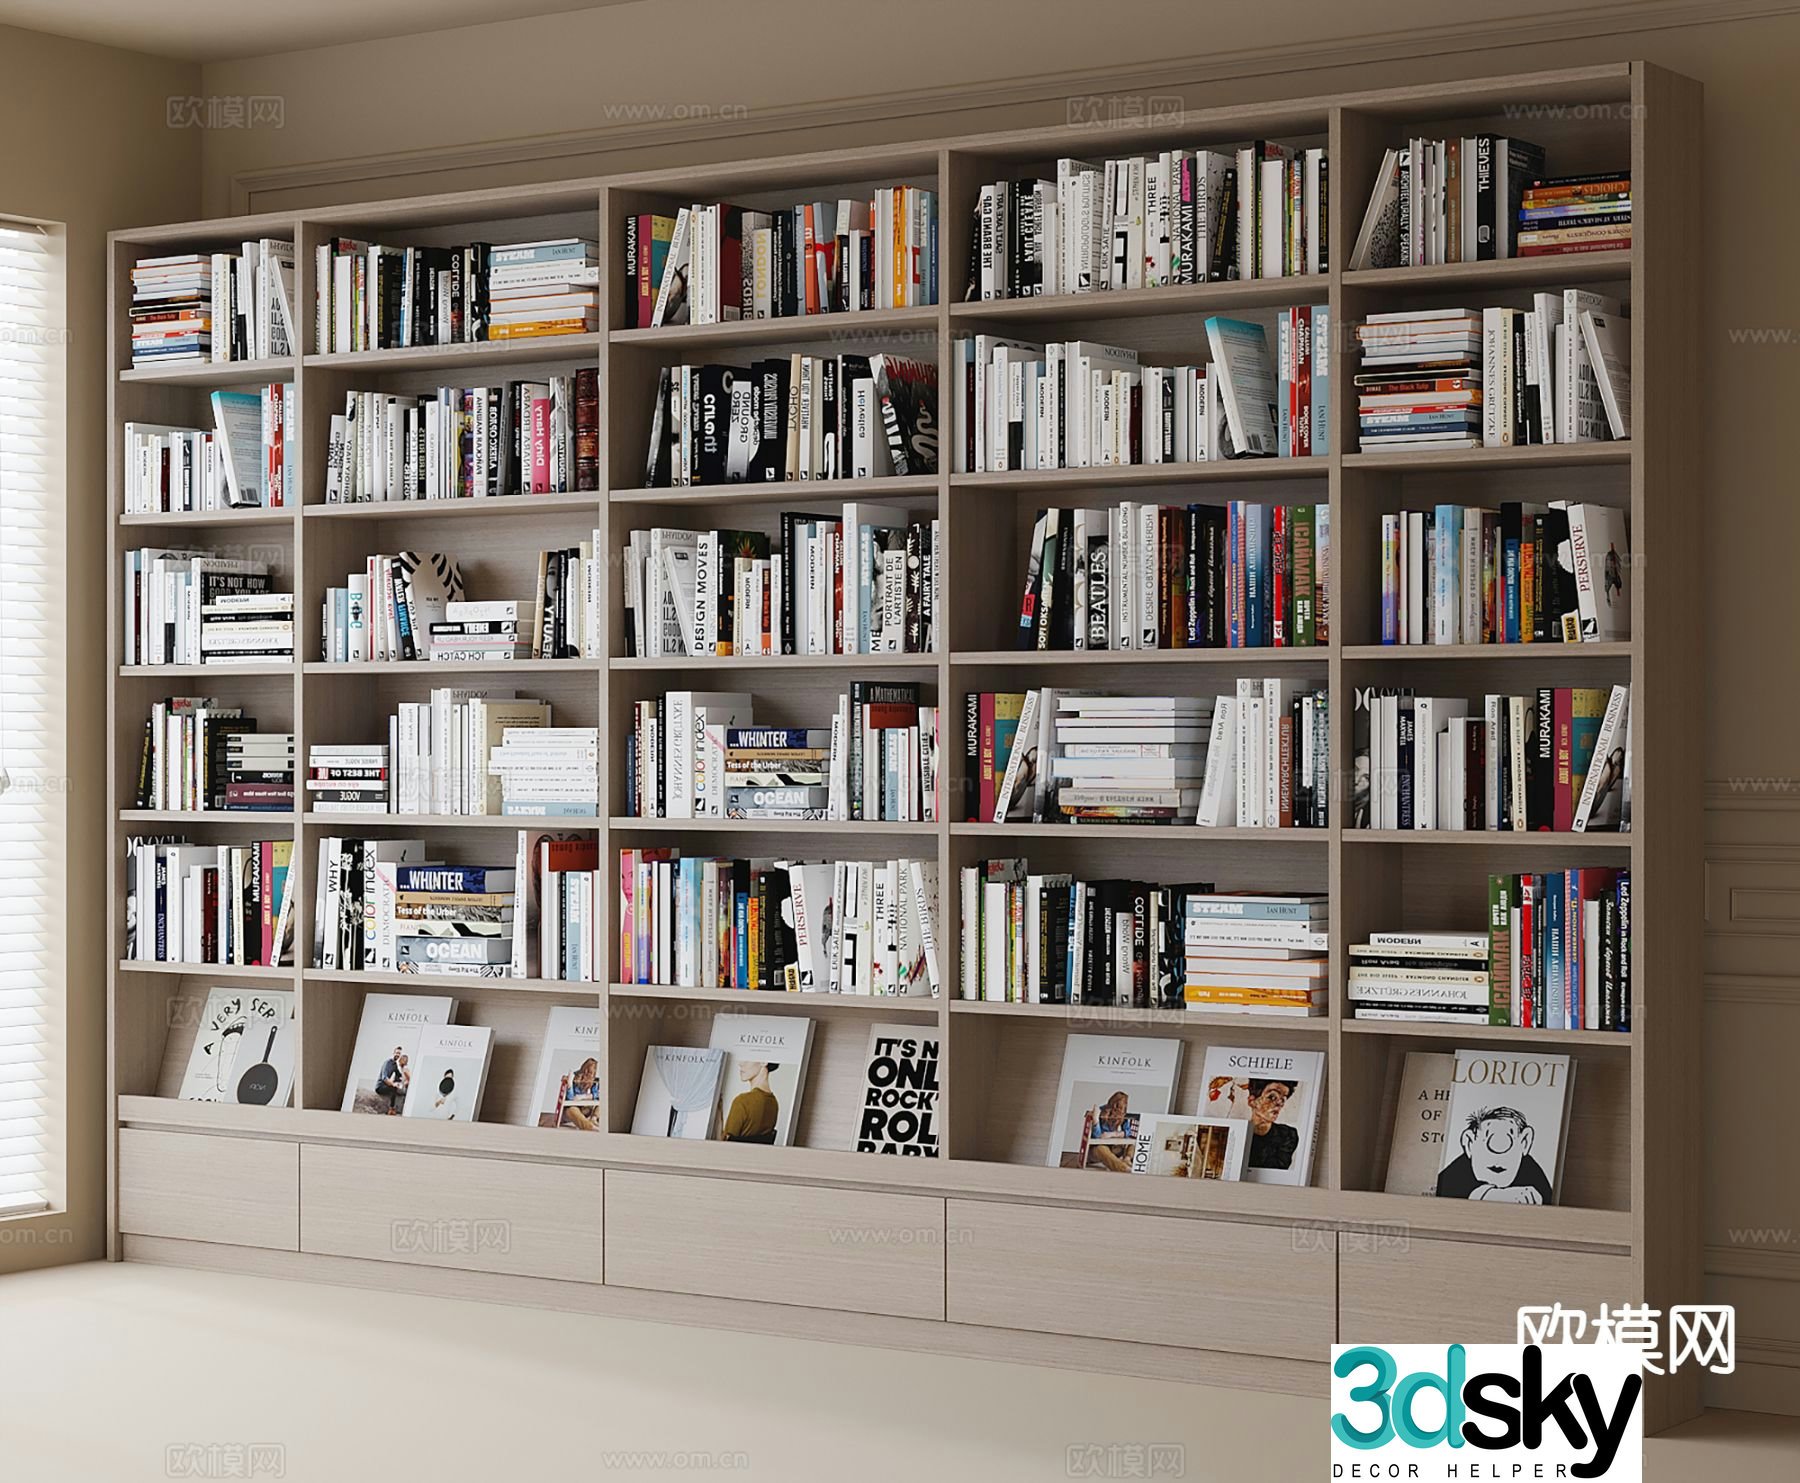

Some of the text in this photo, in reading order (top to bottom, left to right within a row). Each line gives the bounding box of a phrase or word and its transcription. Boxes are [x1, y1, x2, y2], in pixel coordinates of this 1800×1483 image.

[1478, 137, 1490, 193] THIEVES
[1147, 176, 1157, 216] THREE
[1173, 160, 1182, 241] NATIONAL PARK
[1198, 176, 1206, 241] THE BIRDS
[627, 216, 637, 276] MURAKAMI
[1181, 205, 1193, 285] MURAKAMI
[657, 252, 677, 311] INTERNATIONAL
[1487, 329, 1497, 388] JOHANNES
[209, 576, 265, 588] IT'S NOT HOW
[923, 555, 931, 581] TALE
[1121, 507, 1129, 622] INSTRUMENTAL NUMBER BUILDING
[1146, 514, 1154, 621] DESIRE OBTAIN CHERISH
[1573, 523, 1591, 592] PERSERVE
[694, 542, 709, 651] DESIGN MOVES
[885, 573, 893, 627] PORTRAIT
[894, 573, 903, 625] L'ARTISTE
[923, 583, 931, 608] FAIRY
[1089, 551, 1106, 641] BEATLES
[967, 694, 977, 756] MURAKAMI
[1002, 696, 1035, 800] INTERNATIONAL BUSINESS
[1539, 690, 1551, 758] MURAKAMI
[1581, 691, 1623, 806] INTERNATIONAL BUSINESS
[695, 713, 705, 792] color index
[727, 760, 743, 770] Tess
[753, 791, 806, 806] OCEAN
[1400, 774, 1411, 827] ENCHANTRESS
[252, 842, 261, 903] MURAKAMI
[328, 860, 339, 893] WHY
[365, 849, 376, 941] color index
[397, 906, 415, 916] Tess
[791, 884, 808, 947] PERSERVE
[900, 867, 909, 951] NATIONAL PARK
[1279, 906, 1297, 915] HUNT
[1621, 896, 1630, 929] Zeppelin
[425, 942, 482, 960] OCEAN
[203, 1042, 214, 1055] A
[210, 998, 240, 1032] VERY
[387, 1012, 431, 1023] KINFOLK
[438, 1039, 473, 1048] KINFOLK
[739, 1034, 785, 1046] KINFOLK
[663, 1053, 705, 1064] KINFOLK
[874, 1037, 918, 1058] IT'S
[1098, 1055, 1152, 1068] KINFOLK
[1228, 1055, 1293, 1070] SCHIELE
[1451, 1058, 1566, 1087] LORIOT
[1418, 1090, 1428, 1100] A
[1421, 1110, 1442, 1120] OF
[1134, 1134, 1151, 1172] HOME
